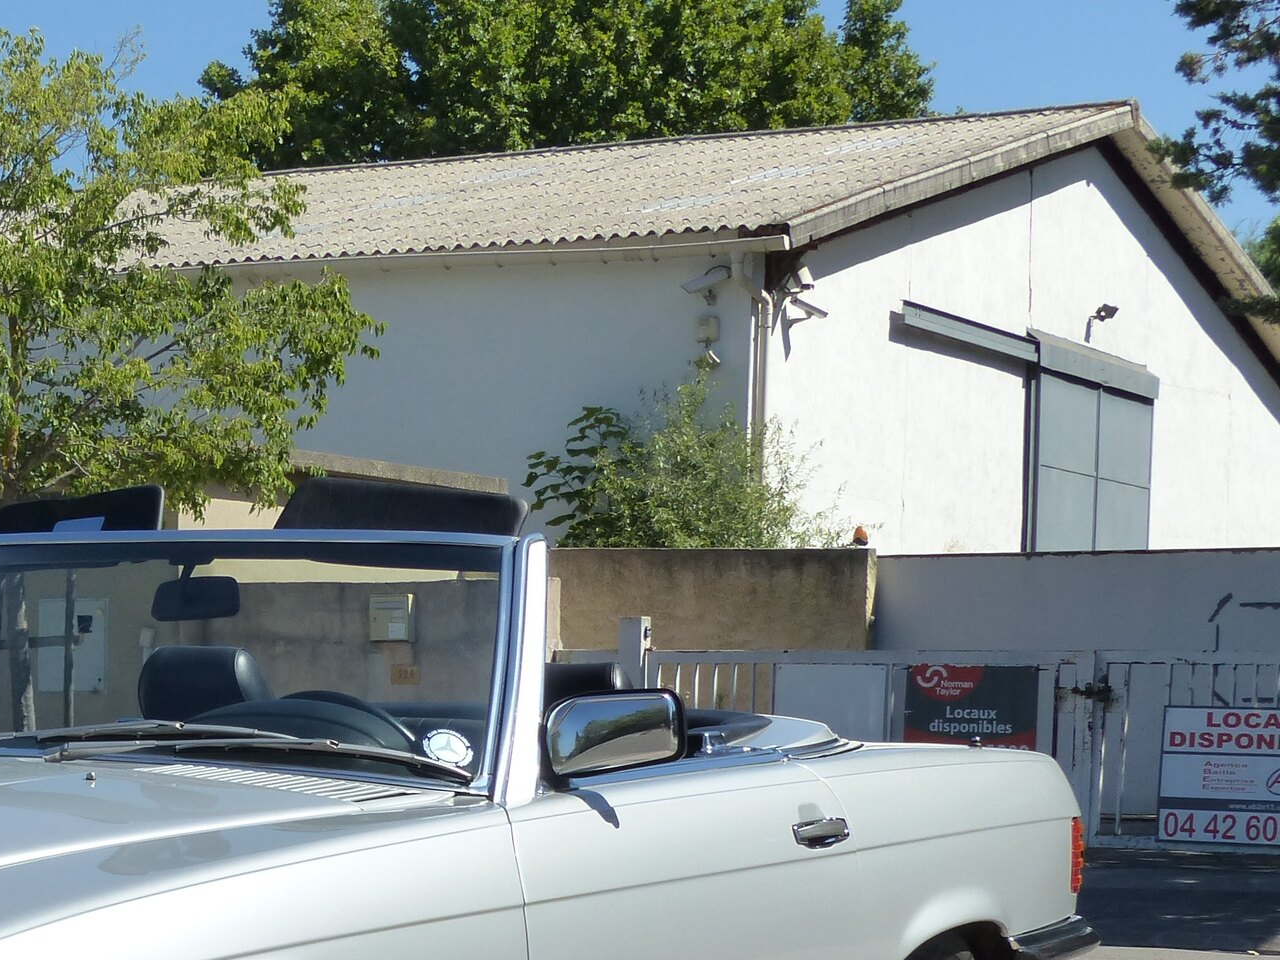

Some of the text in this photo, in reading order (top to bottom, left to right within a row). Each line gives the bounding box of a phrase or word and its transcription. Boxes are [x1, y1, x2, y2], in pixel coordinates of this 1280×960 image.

[940, 680, 974, 689] Norman
[935, 687, 961, 696] Taylor
[945, 705, 998, 720] Locaux
[928, 719, 1013, 735] disponibles
[1203, 760, 1249, 769] Agence
[1163, 811, 1278, 842] 04 42 60
